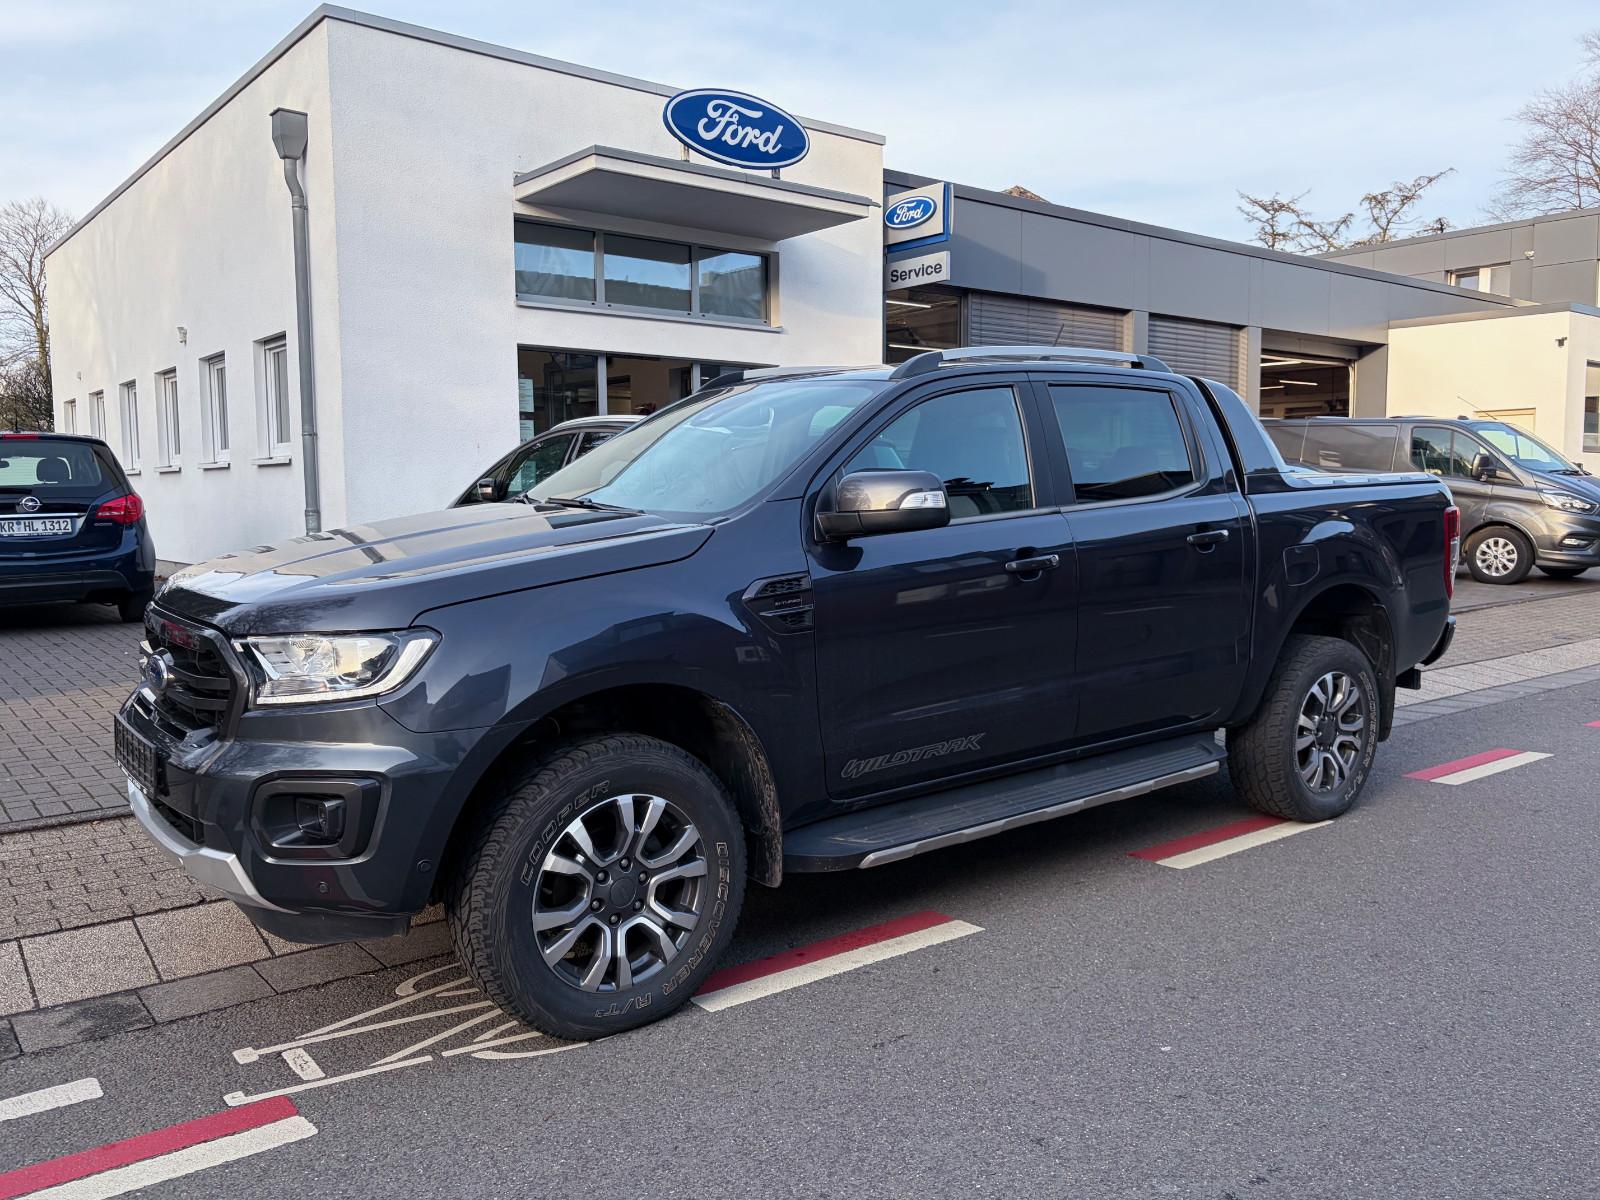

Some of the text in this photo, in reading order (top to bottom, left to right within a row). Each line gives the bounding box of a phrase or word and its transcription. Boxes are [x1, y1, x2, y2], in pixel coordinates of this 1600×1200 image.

[697, 99, 784, 154] Ford
[893, 201, 923, 224] Ford
[890, 261, 943, 283] Service
[0, 519, 70, 533] KR HL 1312
[840, 732, 987, 779] WILDTRAK
[520, 780, 610, 887] COOPER
[662, 842, 730, 996] DISCOVERER
